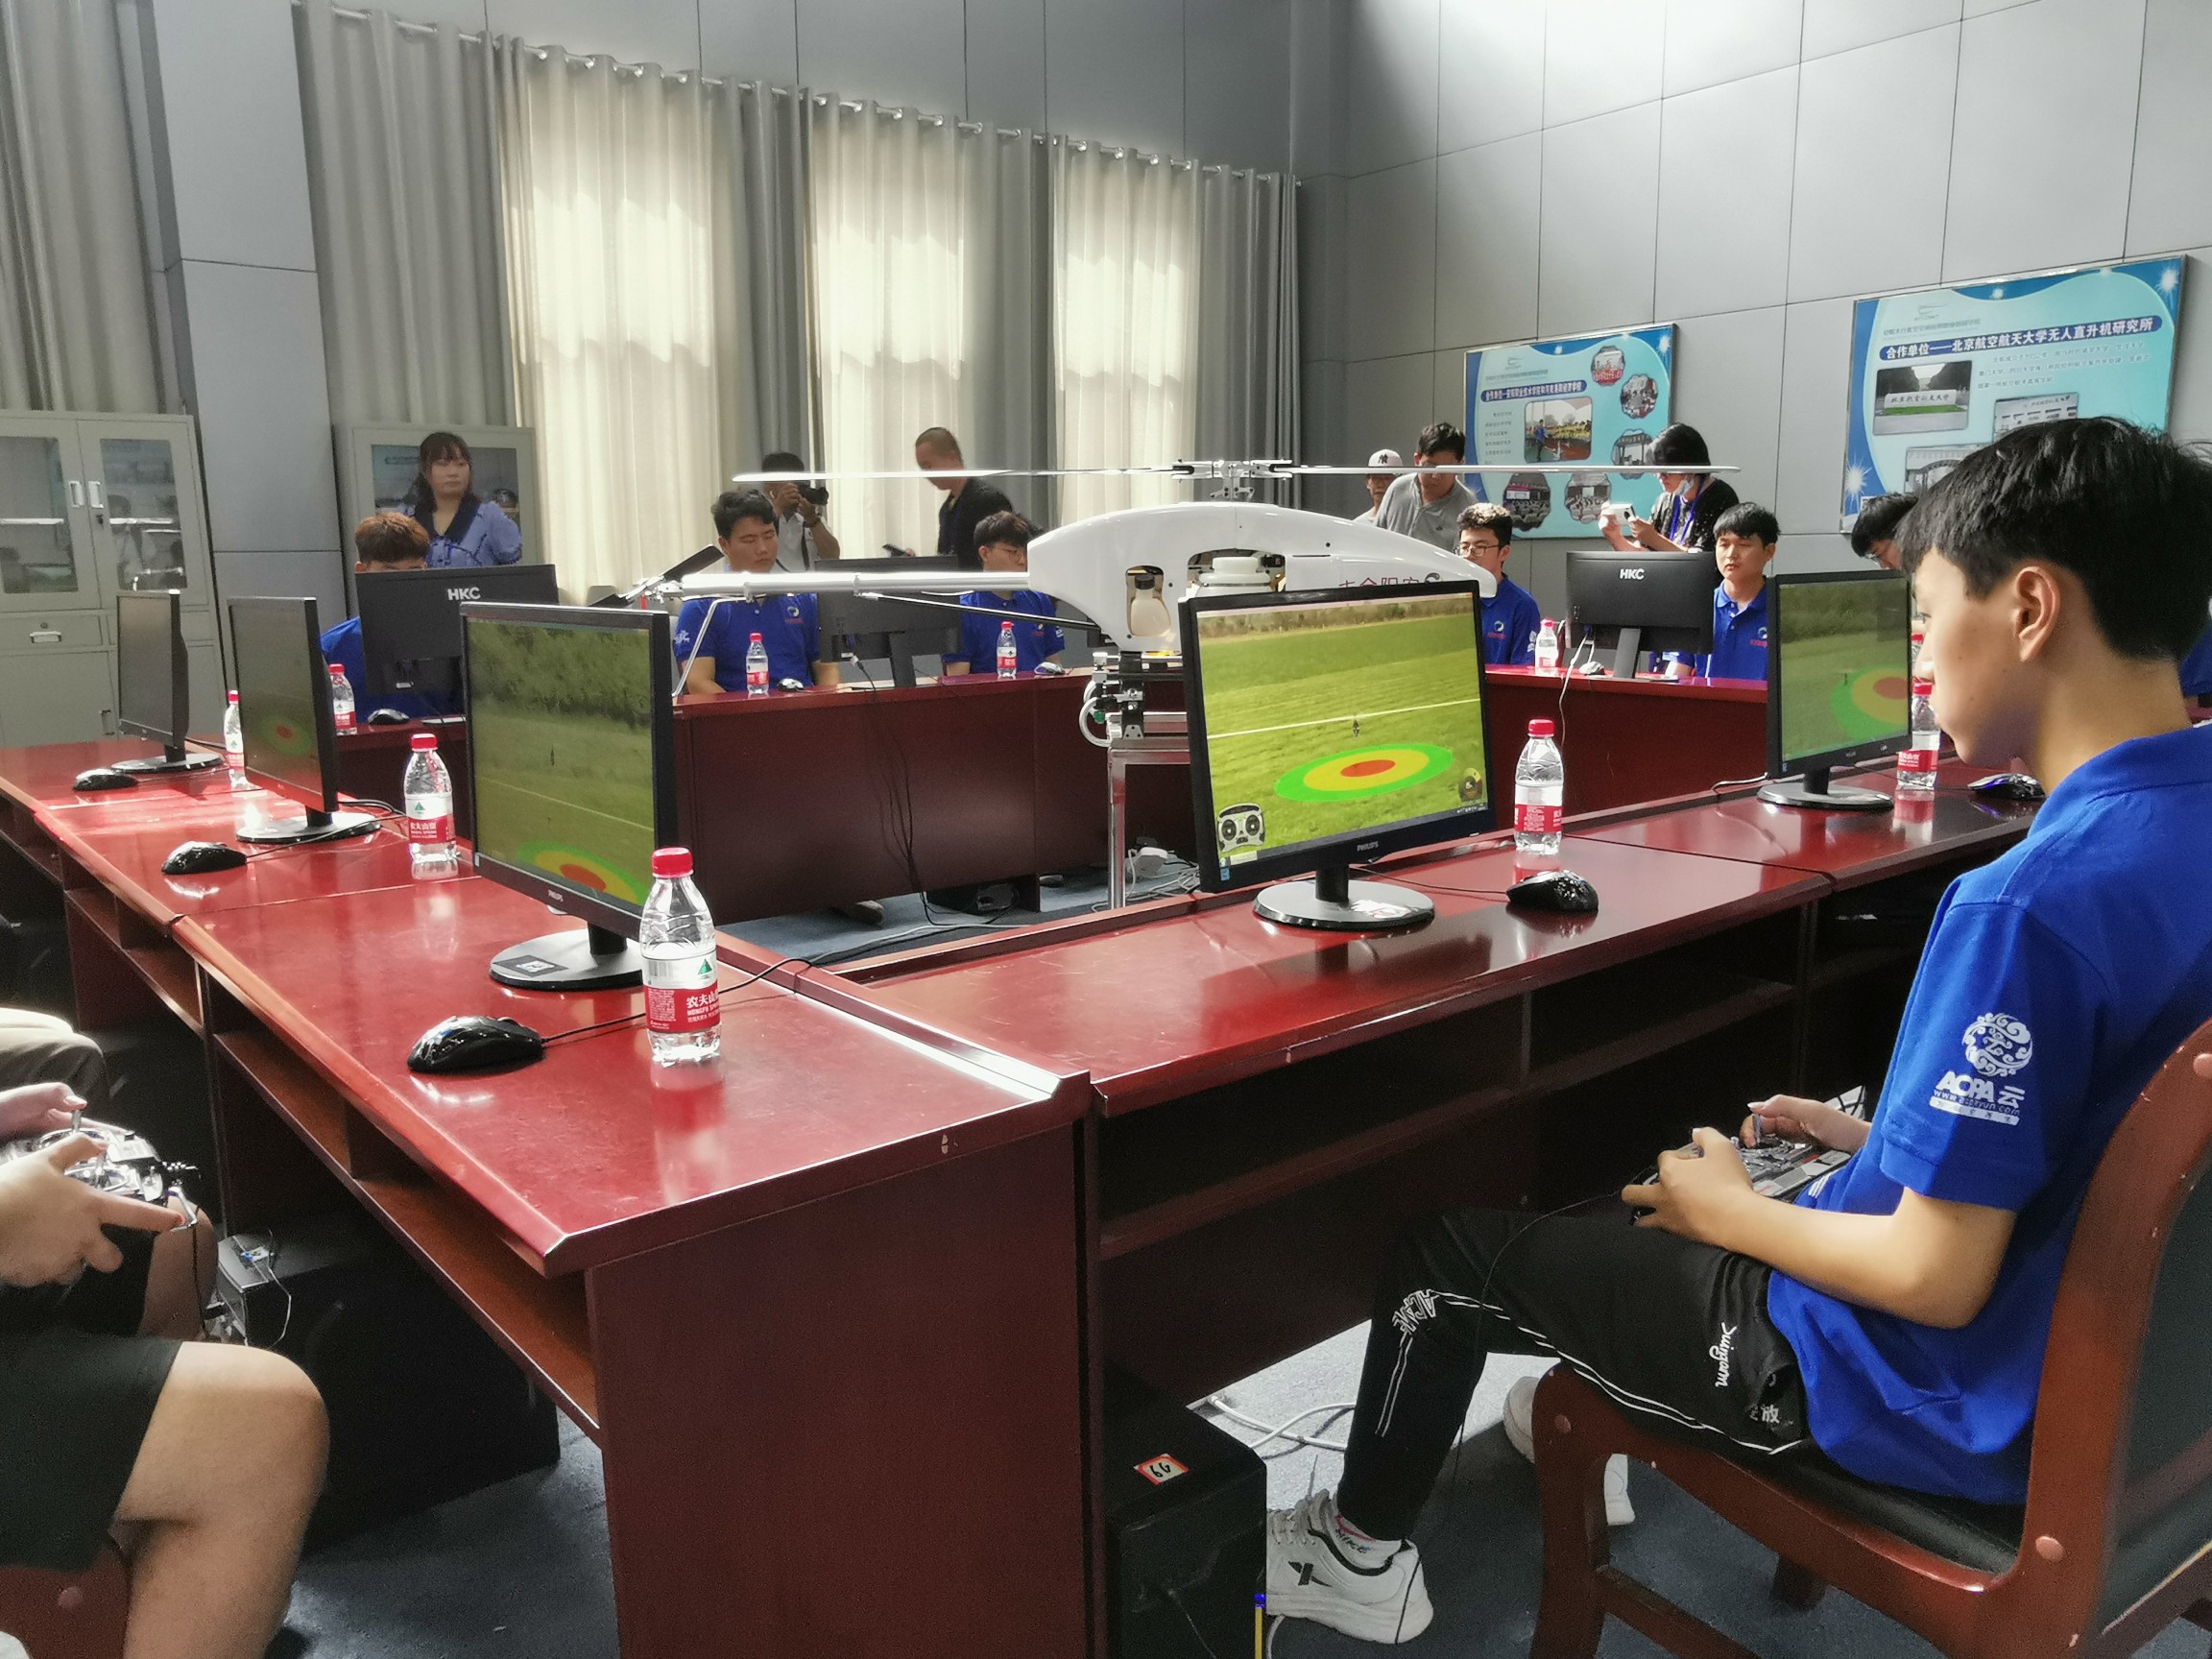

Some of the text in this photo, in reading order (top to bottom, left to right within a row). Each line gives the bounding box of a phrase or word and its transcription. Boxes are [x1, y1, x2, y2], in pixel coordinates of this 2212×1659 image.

[1620, 567, 1646, 581] HKC
[447, 586, 482, 601] HKC
[1935, 1070, 1995, 1103] AOPA
